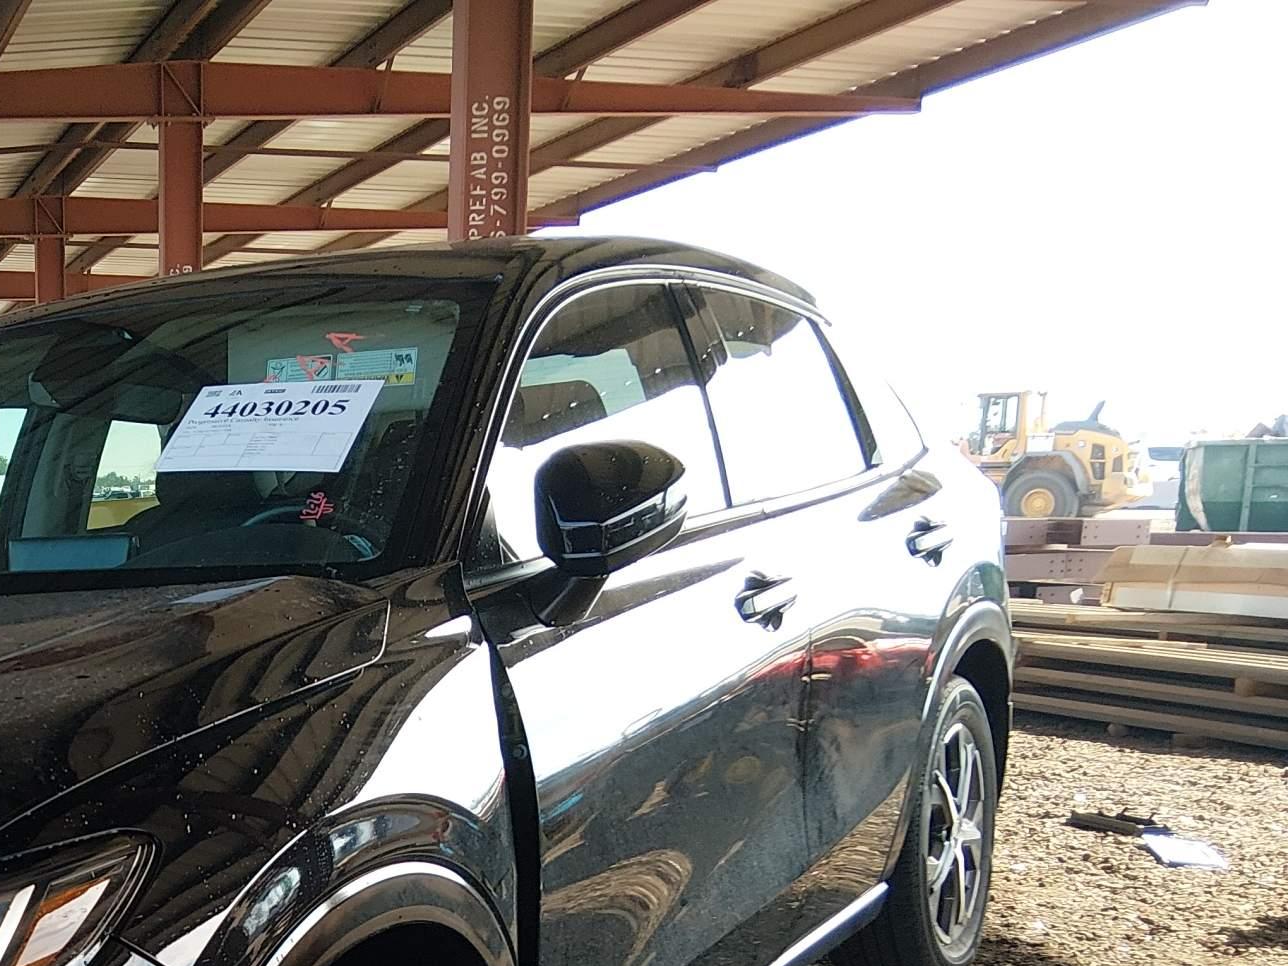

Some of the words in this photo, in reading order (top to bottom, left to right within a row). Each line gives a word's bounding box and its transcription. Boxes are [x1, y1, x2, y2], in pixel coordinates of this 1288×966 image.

[471, 95, 489, 139] INC.
[468, 151, 487, 240] PREFAB
[203, 399, 351, 418] 44030205
